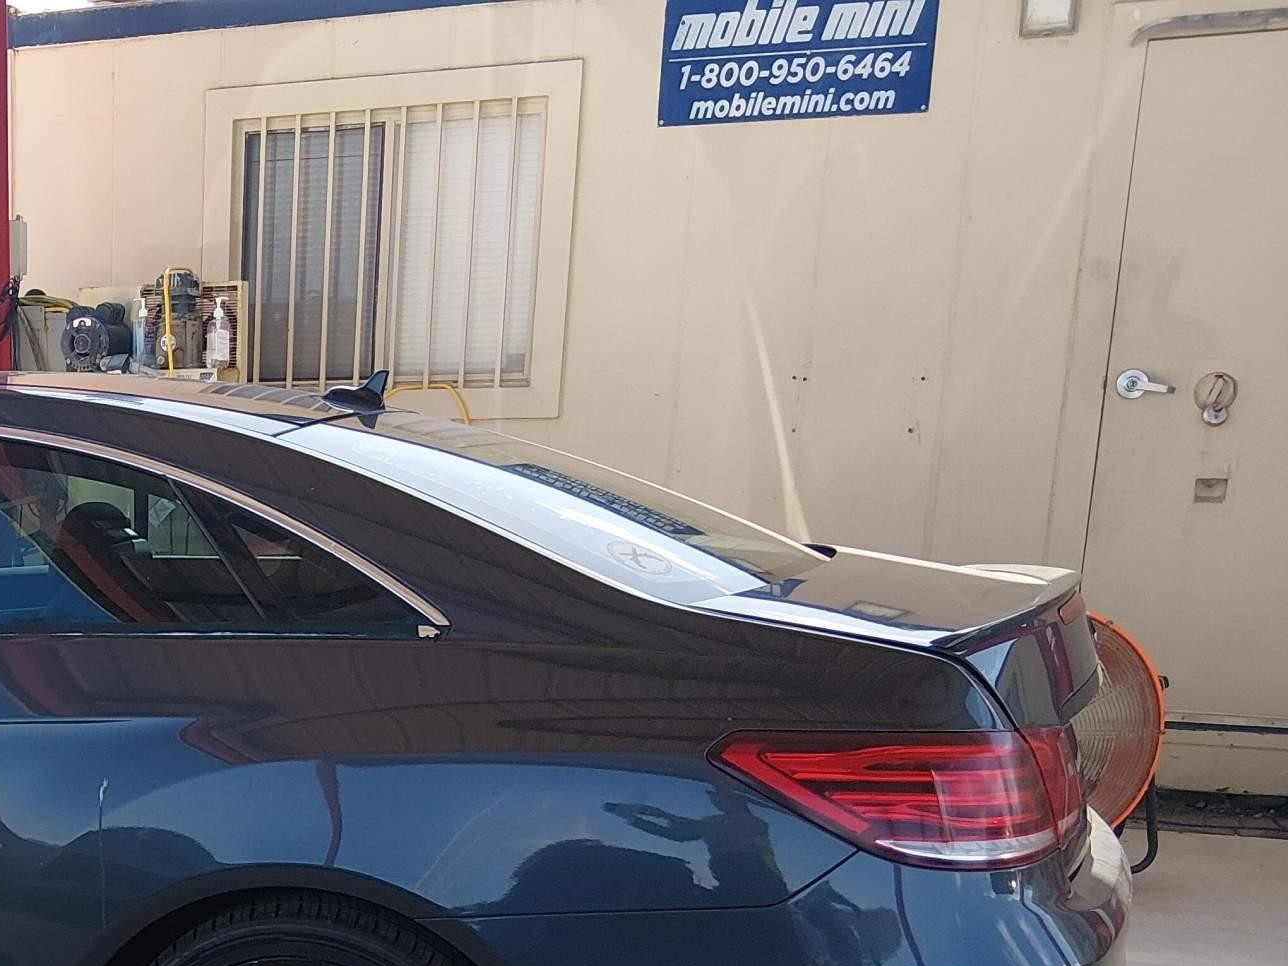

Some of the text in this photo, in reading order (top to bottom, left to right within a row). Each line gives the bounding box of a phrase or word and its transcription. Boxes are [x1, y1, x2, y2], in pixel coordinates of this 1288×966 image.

[671, 0, 926, 51] mobile mini
[679, 50, 913, 91] 1-800-950-6464
[689, 87, 896, 120] mobilemini.com
